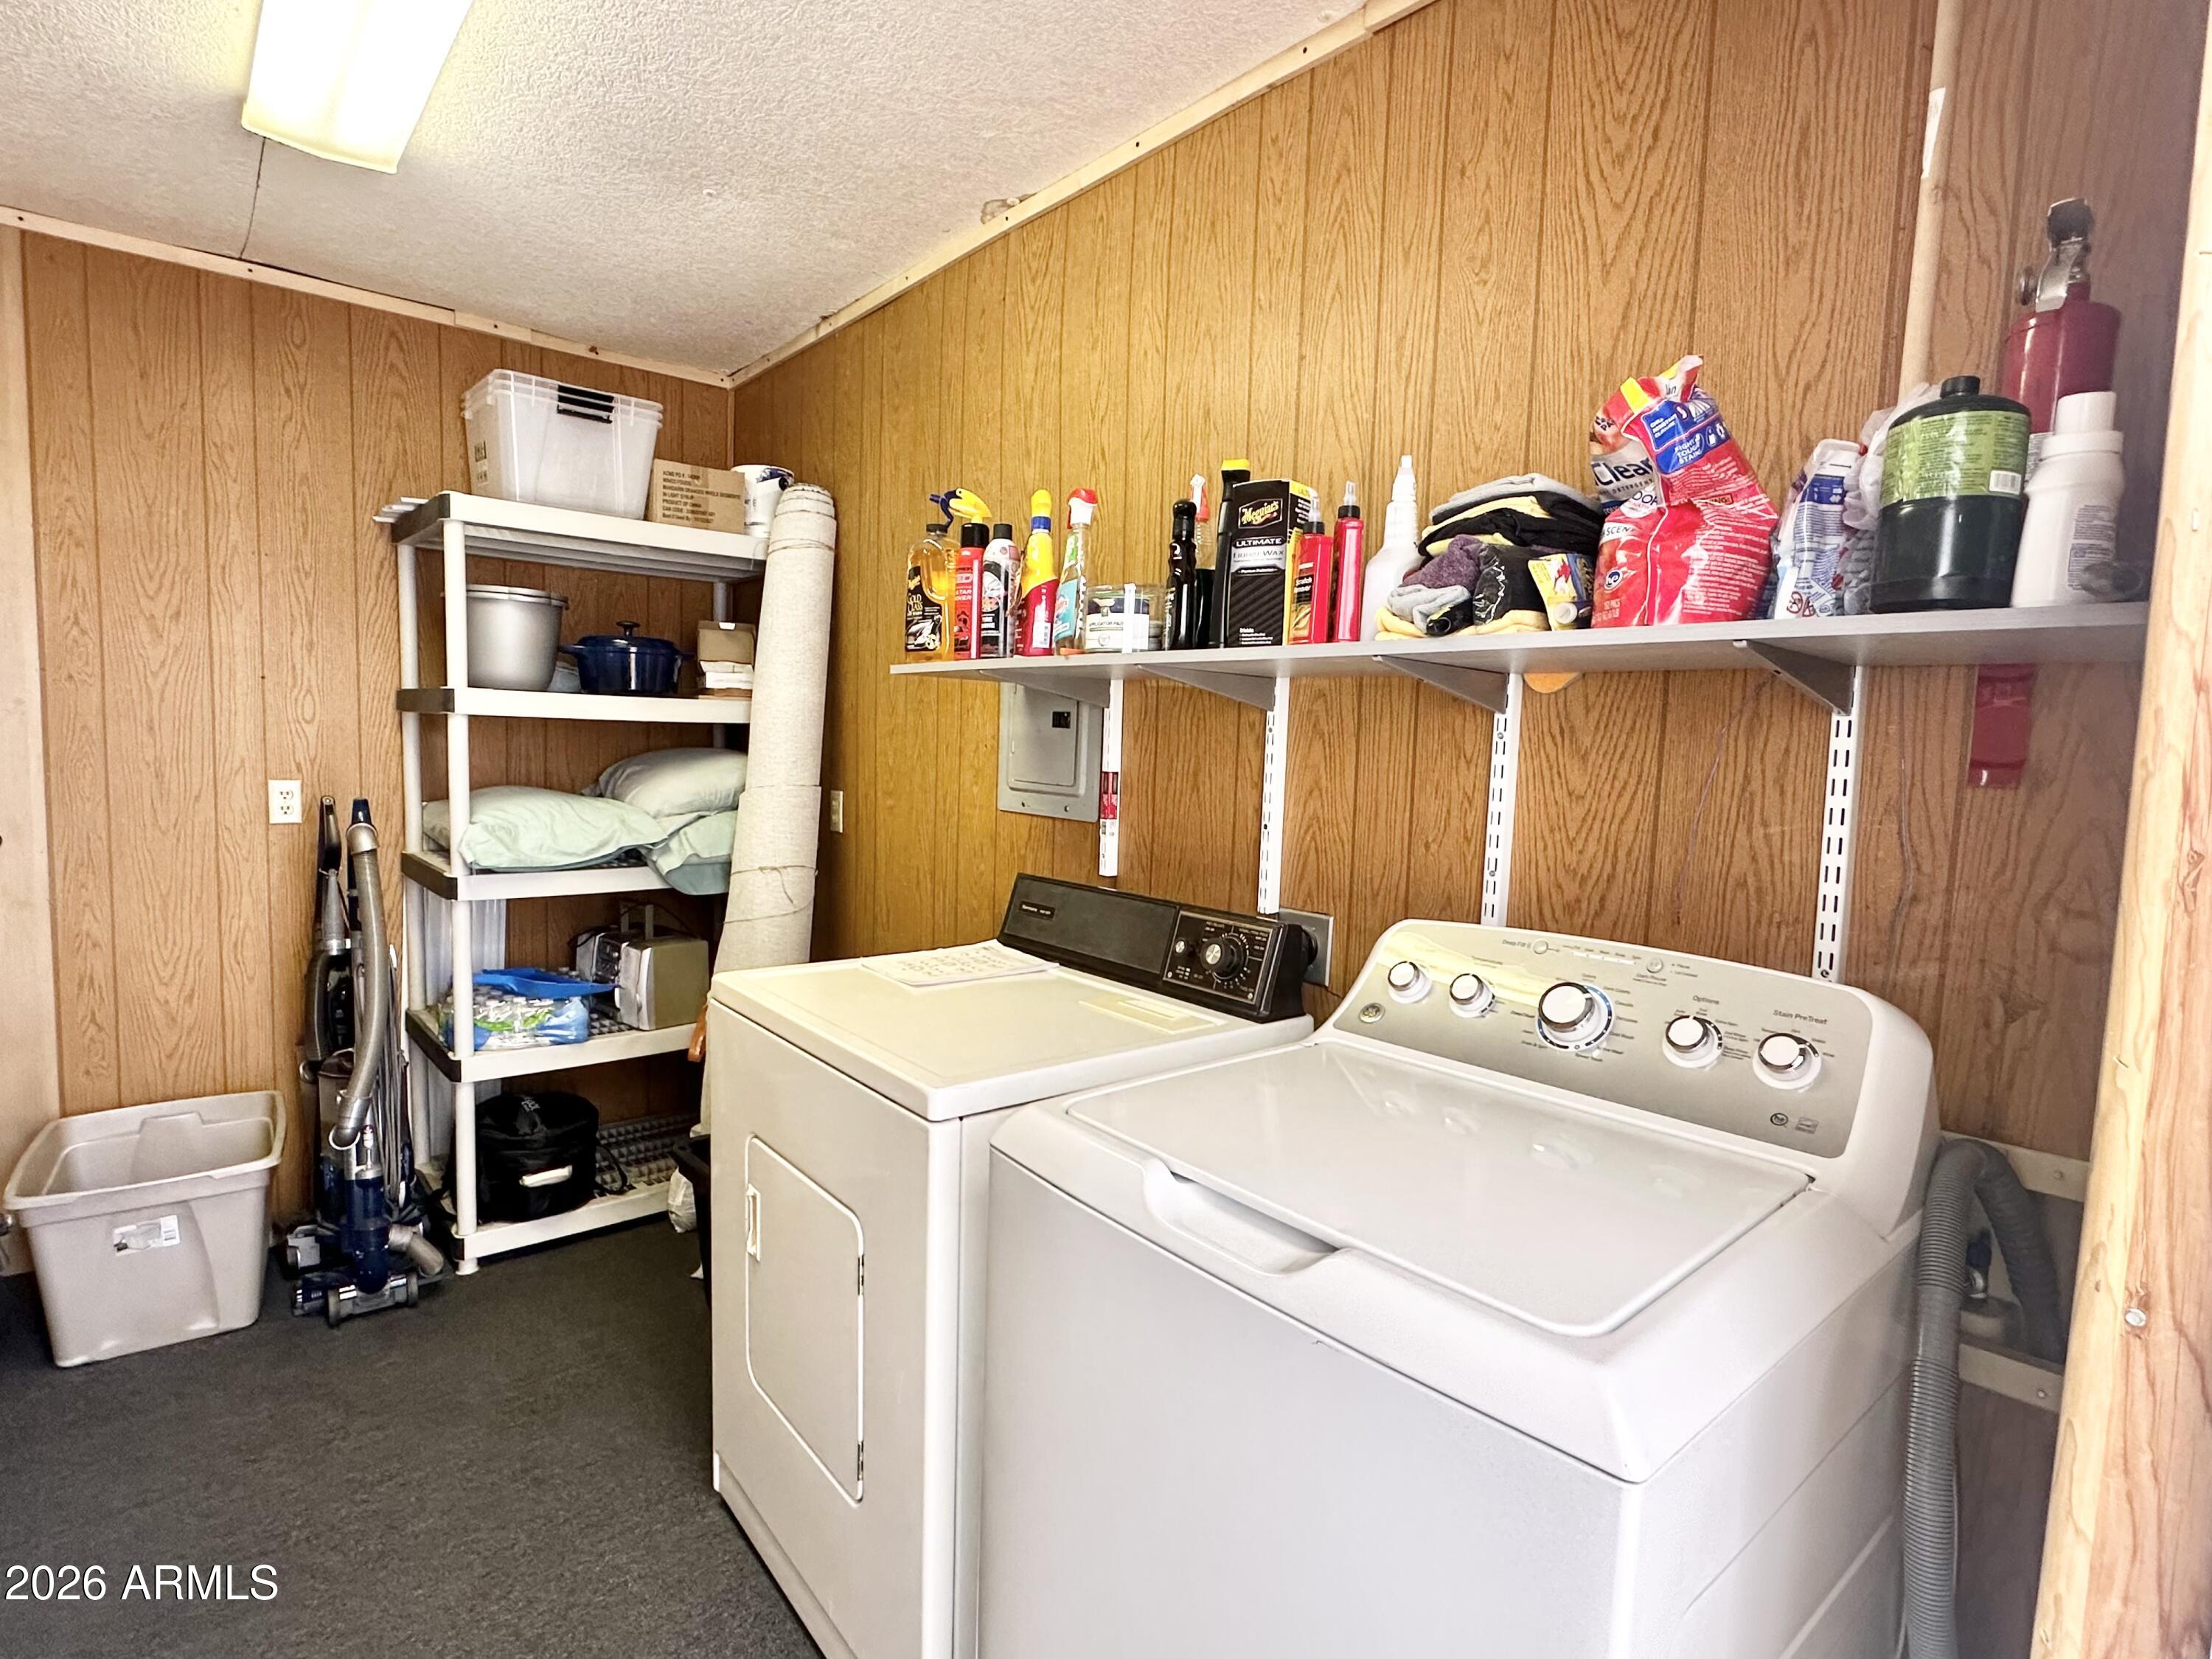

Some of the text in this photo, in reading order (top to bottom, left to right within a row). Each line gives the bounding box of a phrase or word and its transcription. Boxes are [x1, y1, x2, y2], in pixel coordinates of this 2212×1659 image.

[1236, 538, 1282, 547] ULTIMATE
[1693, 995, 1719, 1005] Options
[1773, 1009, 1828, 1025] Stain PreTreat
